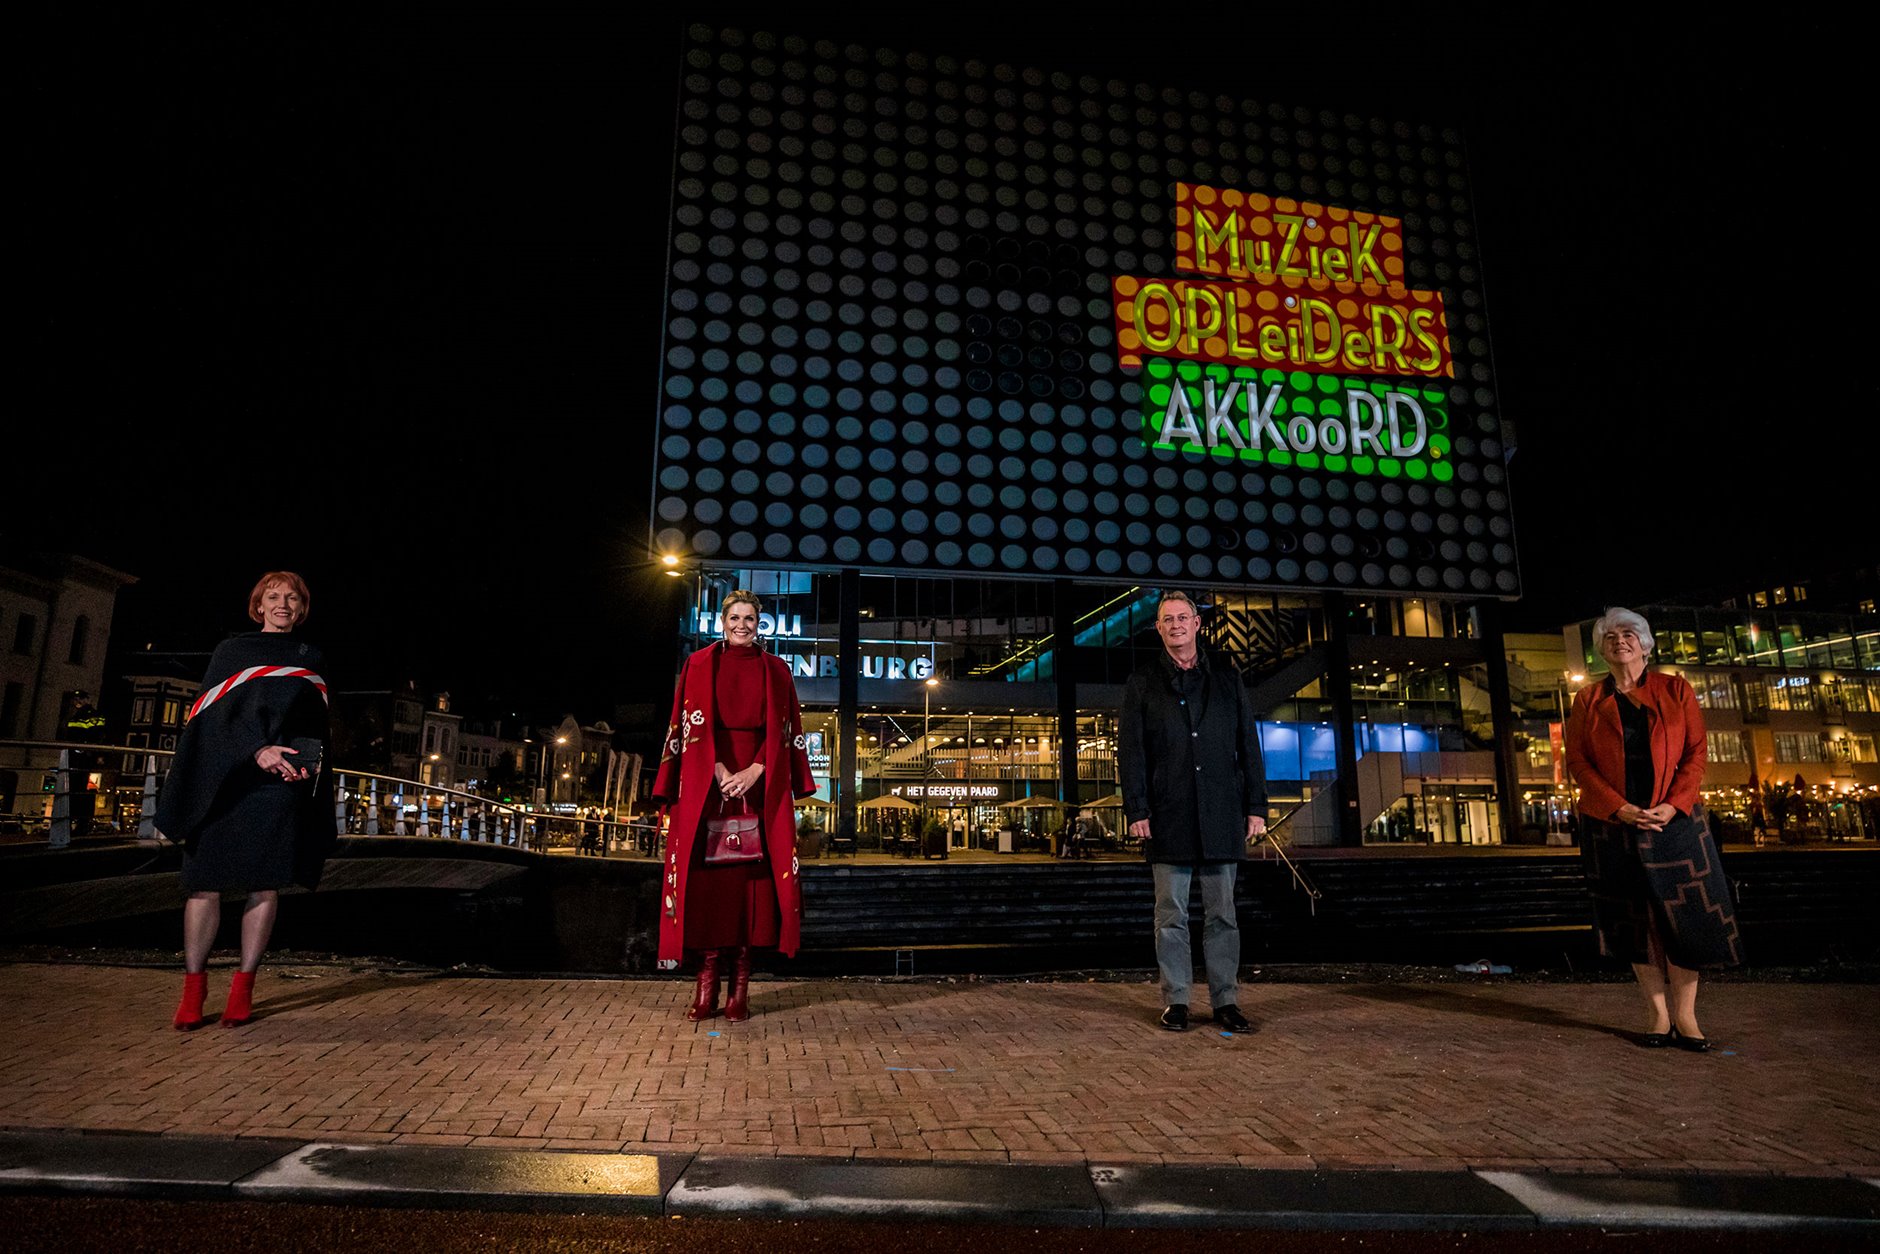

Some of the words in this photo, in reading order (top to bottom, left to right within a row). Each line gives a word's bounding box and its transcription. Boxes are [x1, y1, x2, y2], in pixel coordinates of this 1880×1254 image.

[699, 611, 802, 637] TIOLI
[906, 786, 924, 796] HET
[928, 787, 968, 796] GEGEVEN
[970, 787, 998, 796] PAARD
